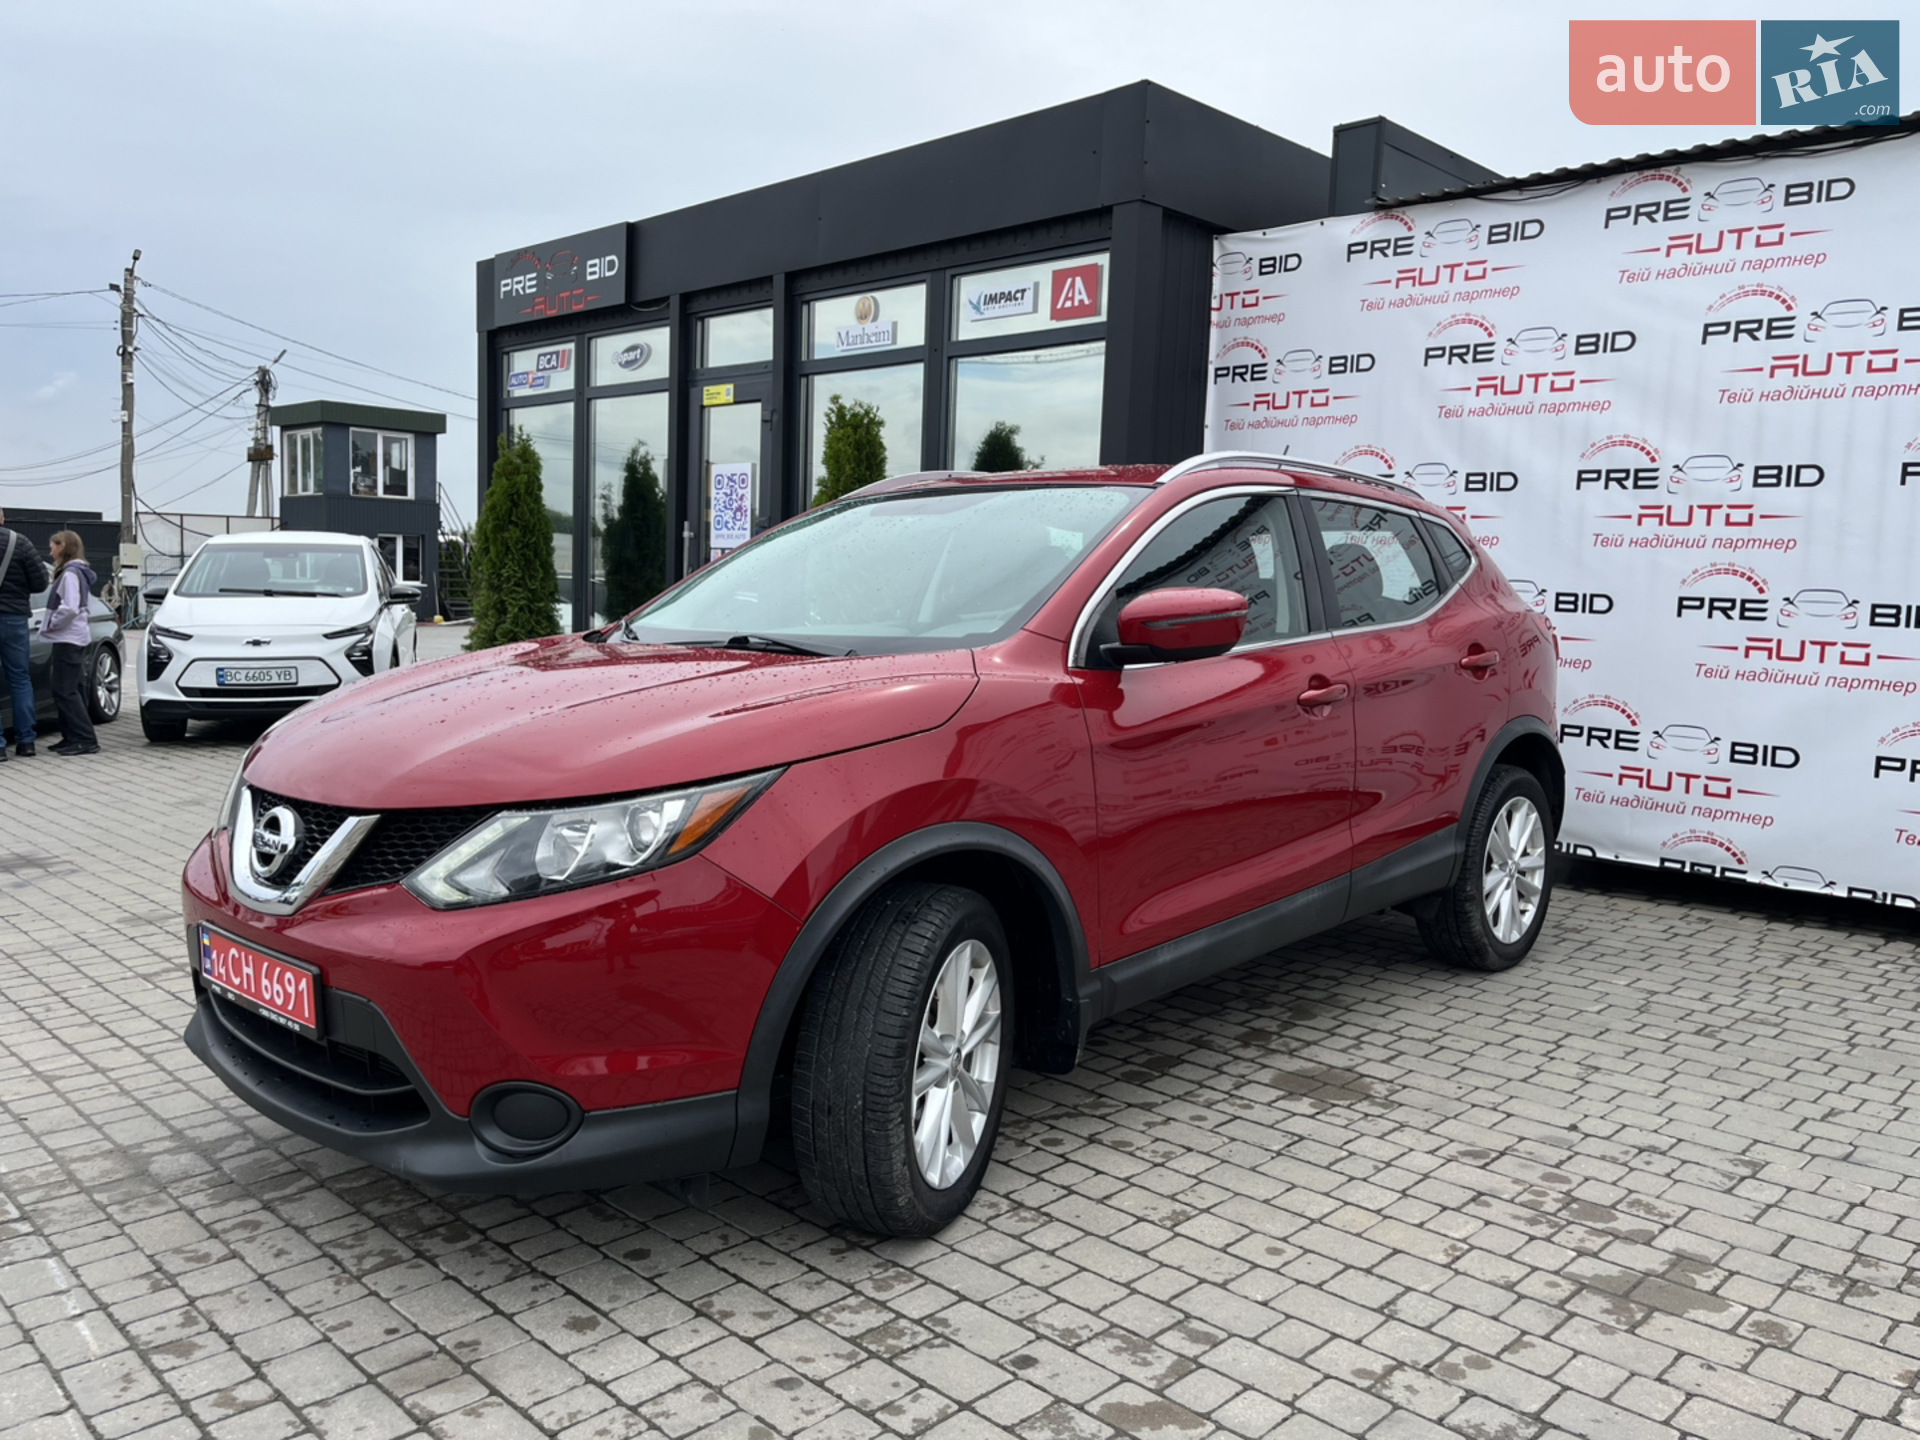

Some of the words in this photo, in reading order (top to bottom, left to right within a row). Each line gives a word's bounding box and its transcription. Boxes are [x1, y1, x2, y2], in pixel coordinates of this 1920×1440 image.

[1604, 197, 1692, 229] PRE
[1783, 177, 1856, 207] BID
[1347, 236, 1415, 263] PRE
[1487, 218, 1545, 245] BID
[1665, 223, 1786, 258] AUTO
[500, 272, 537, 299] PRE
[586, 254, 619, 281] BID
[1258, 253, 1302, 276] BID
[1395, 259, 1488, 289] AUTO
[1618, 269, 1652, 285] Твій
[1655, 259, 1736, 280] надійний
[1741, 252, 1827, 273] партнер
[533, 288, 585, 318] AUTO
[983, 288, 1027, 306] IMPACT
[1211, 289, 1260, 312] UTO
[1359, 298, 1385, 312] Твій
[1388, 291, 1449, 309] надійний
[1452, 285, 1520, 303] партнер
[1233, 312, 1285, 328] партнер
[1701, 316, 1797, 345] PRE
[836, 325, 890, 348] Manheim
[1424, 342, 1496, 367] PRE
[1574, 330, 1637, 356] BID
[538, 354, 557, 369] BCA
[1214, 362, 1268, 385] PRE
[1328, 353, 1376, 375] BID
[1769, 348, 1899, 379] AUTO
[1475, 370, 1576, 397] AUTO
[1718, 388, 1754, 404] Твій
[1759, 383, 1846, 402] надійний
[1851, 383, 1920, 401] партн
[1253, 388, 1330, 411] AUTO
[1437, 405, 1464, 419] Твій
[1467, 401, 1534, 418] надійний
[1538, 399, 1612, 417] партнер
[1224, 418, 1245, 431] Твій
[1247, 415, 1299, 429] надійний
[1301, 413, 1358, 427] партнер
[1464, 472, 1519, 492] BID
[1576, 468, 1660, 490] PRE
[1752, 464, 1825, 488] BID
[1637, 504, 1754, 527] AUTO
[1592, 533, 1624, 548] Твій
[1628, 533, 1707, 549] надійний
[1711, 536, 1797, 553] партнер
[1554, 592, 1614, 615] BID
[1677, 596, 1769, 621] PRE
[1869, 603, 1920, 629] BI
[1744, 636, 1872, 667] AUTO
[225, 671, 242, 682] BC
[244, 671, 273, 682] 6605
[1695, 663, 1730, 680] Твій
[1734, 668, 1820, 687] надійний
[1825, 675, 1917, 696] партнер
[1559, 724, 1641, 752] PRE
[1729, 741, 1801, 769] BID
[1618, 765, 1732, 800] AUTO
[1574, 787, 1606, 804] Твій
[1610, 793, 1687, 815] надійний
[1691, 804, 1774, 830] партнер
[261, 962, 309, 1018] 6691
